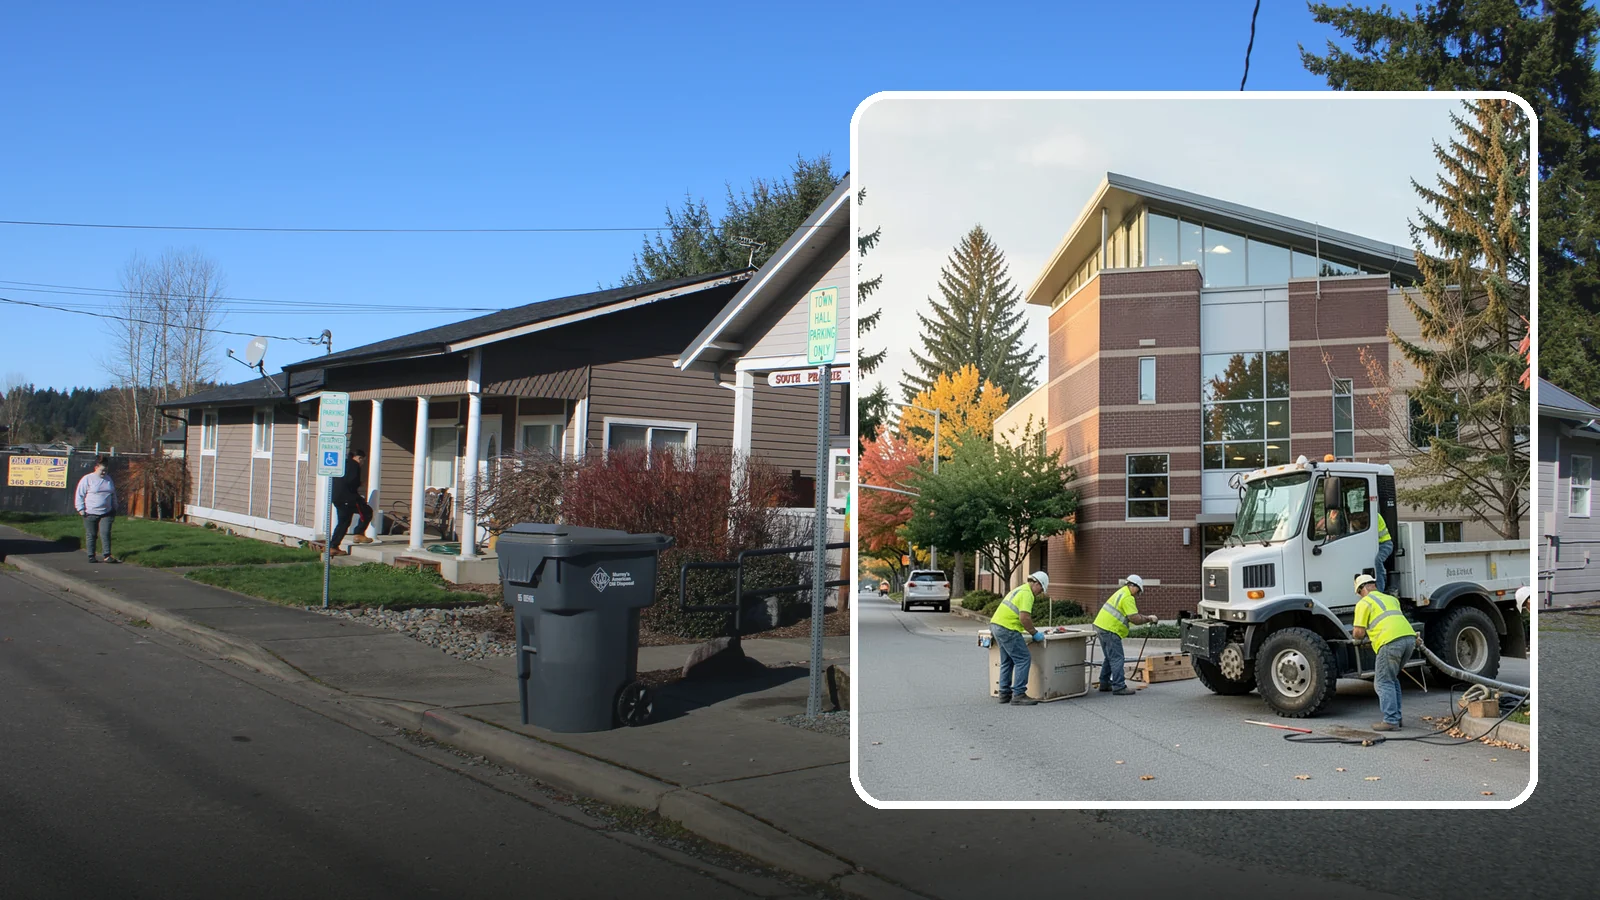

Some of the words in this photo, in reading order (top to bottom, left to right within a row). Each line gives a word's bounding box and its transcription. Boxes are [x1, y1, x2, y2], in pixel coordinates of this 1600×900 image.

[815, 294, 833, 308] TOWN
[814, 311, 831, 324] HALL
[810, 326, 836, 341] PARKING
[813, 344, 831, 357] ONLY
[775, 373, 801, 384] SOUTH
[808, 370, 842, 382] PRIE
[322, 409, 345, 417] PARKING
[325, 420, 340, 428] ONLY
[321, 443, 343, 451] PARKING
